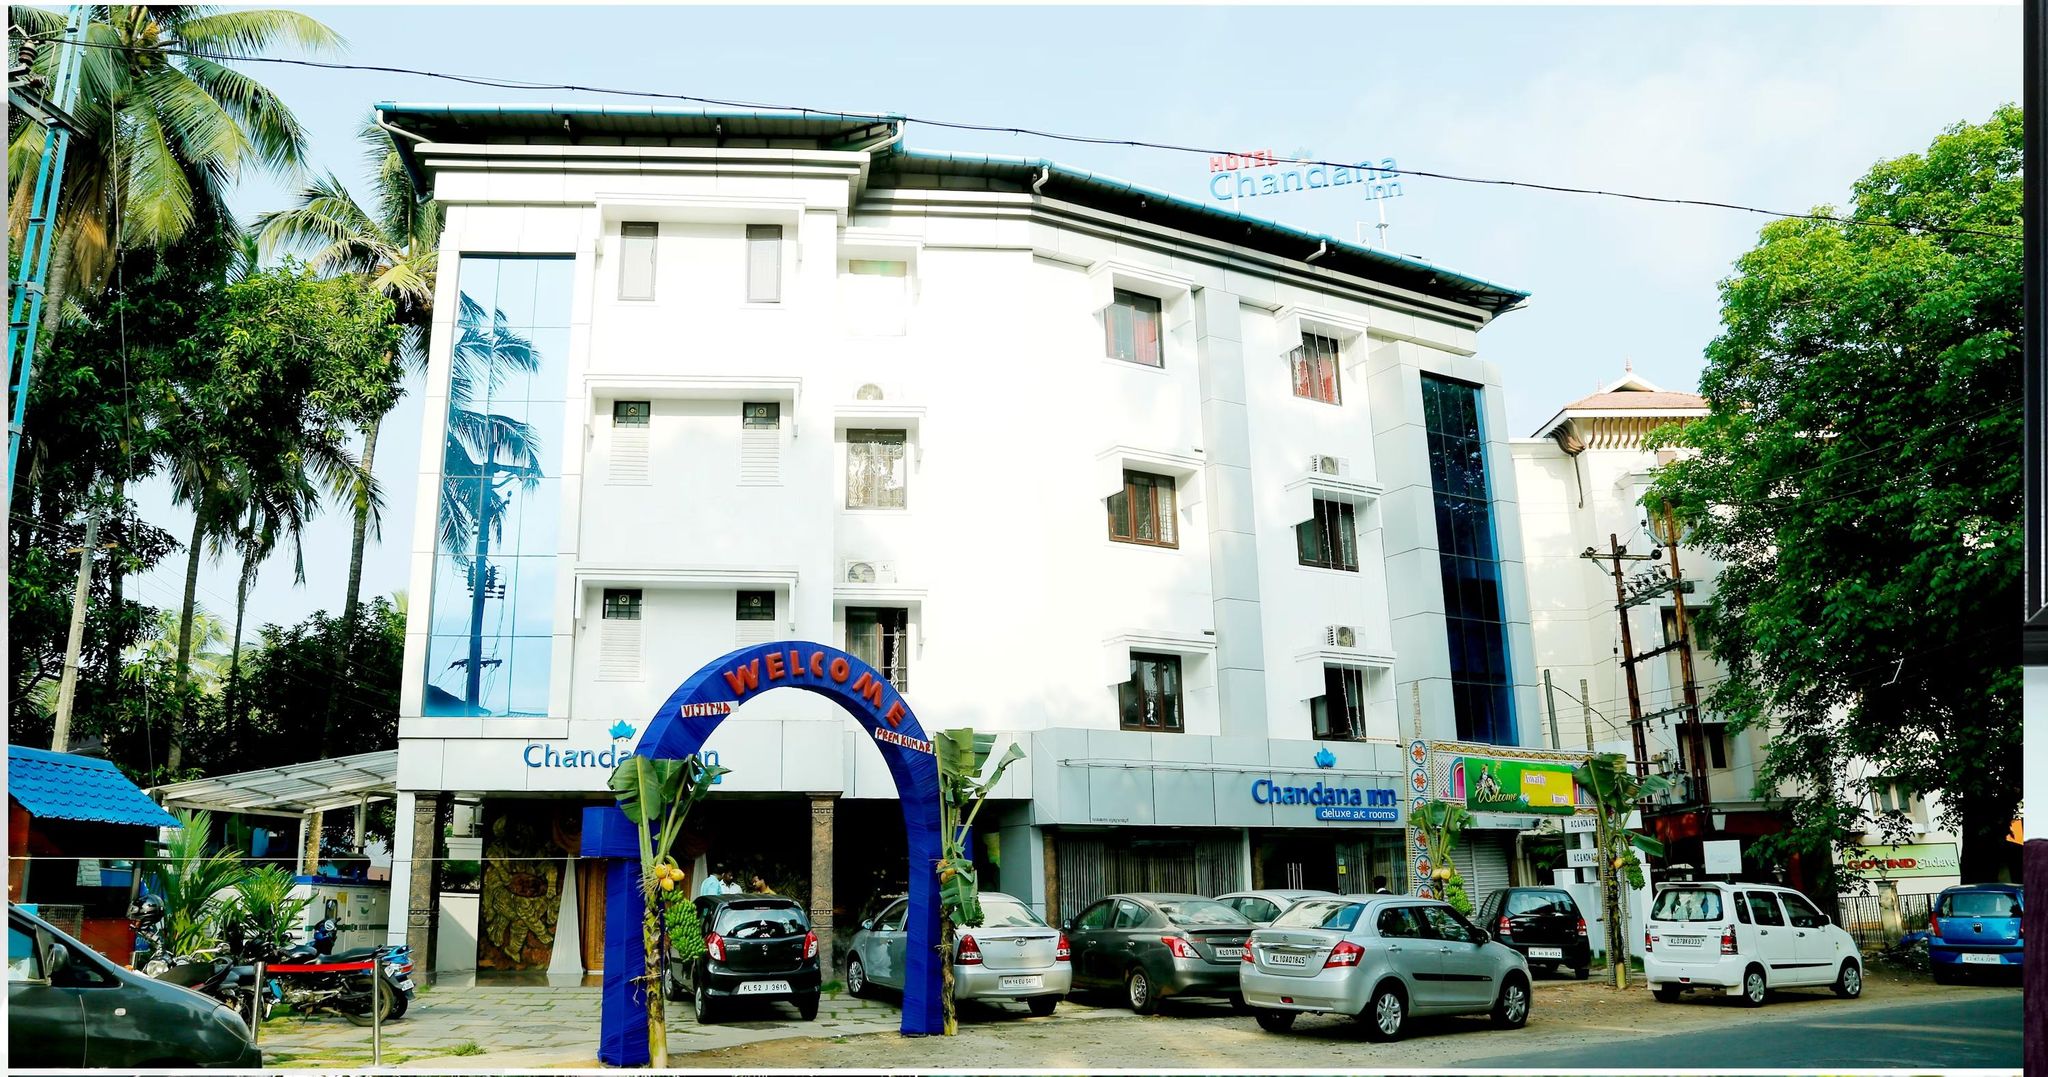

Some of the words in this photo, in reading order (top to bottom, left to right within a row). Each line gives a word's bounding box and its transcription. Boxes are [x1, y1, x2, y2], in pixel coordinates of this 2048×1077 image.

[1209, 148, 1280, 173] HOTEL
[1208, 156, 1401, 201] Chandana
[723, 650, 907, 729] WELCOME
[683, 702, 731, 718] VIJITHA
[877, 727, 900, 745] PREM
[901, 734, 932, 754] KUMAR
[523, 743, 633, 769] Chanda
[1251, 778, 1363, 807] Chandana
[1474, 786, 1518, 803] Welcome
[1321, 808, 1351, 818] deluxe
[1353, 810, 1366, 819] a/c
[1368, 811, 1396, 819] rooms
[1917, 857, 1957, 870] Enclave
[743, 984, 752, 992] KL
[771, 983, 788, 991] 3610
